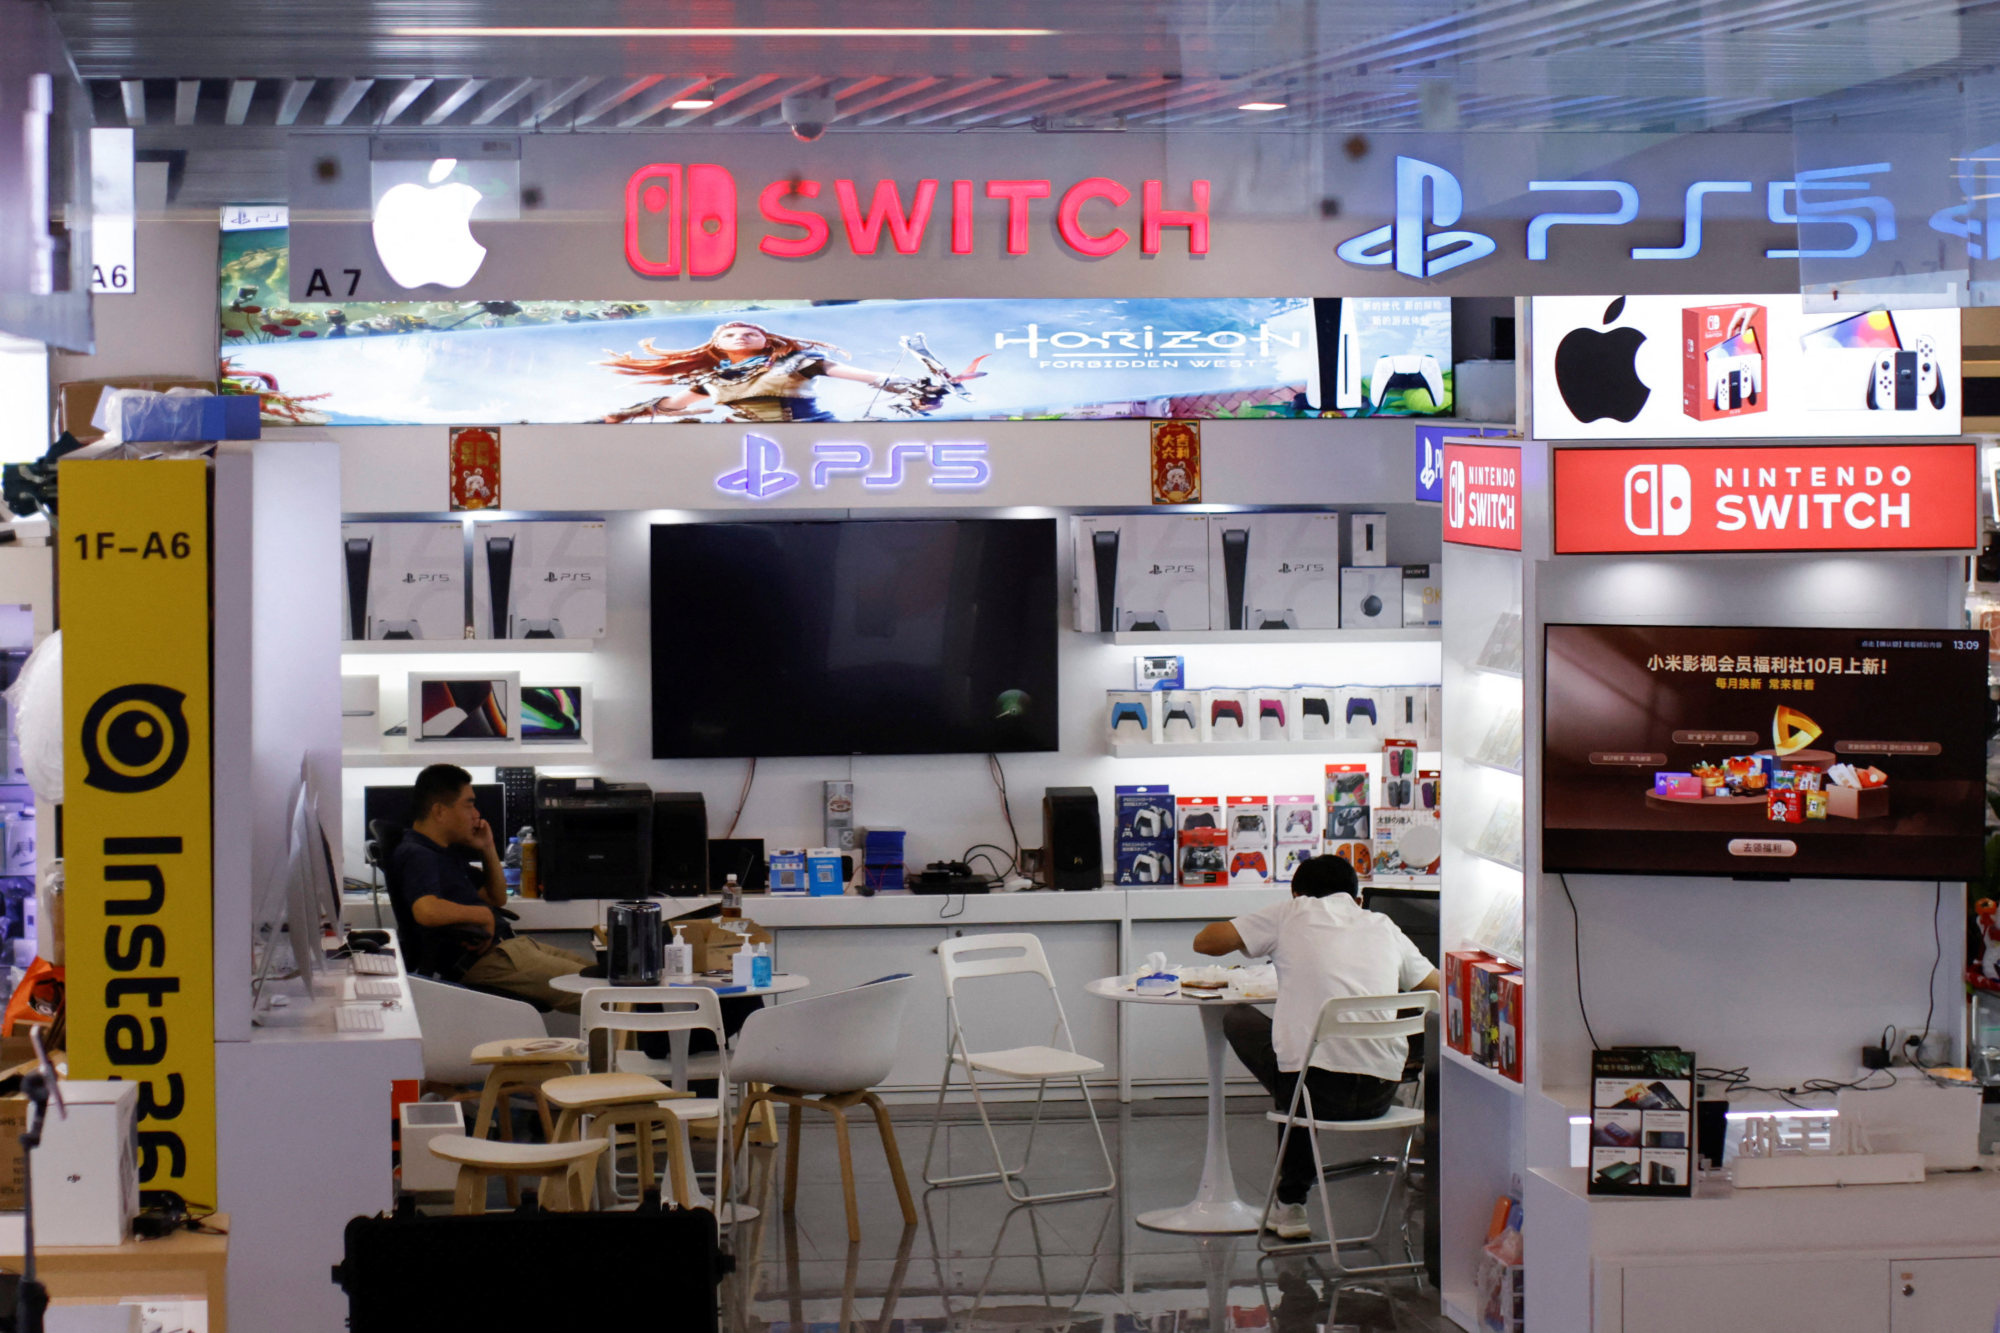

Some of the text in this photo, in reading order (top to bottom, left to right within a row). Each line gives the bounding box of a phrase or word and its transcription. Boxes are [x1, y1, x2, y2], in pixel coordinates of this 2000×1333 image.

[758, 178, 1211, 258] SWITCH
[1525, 180, 1873, 259] PS5
[995, 323, 1300, 358] HORIZON
[1039, 360, 1257, 369] FORBIDDEN WEST
[811, 442, 990, 487] PS5
[1468, 466, 1516, 488] NINTENDO
[1715, 465, 1912, 488] NINTENDO
[1468, 491, 1515, 530] SWITCH
[1715, 493, 1912, 531] SWITCH
[74, 532, 191, 560] 1F-A6
[418, 573, 450, 582] PS5
[560, 572, 592, 582] PS5
[1165, 565, 1195, 573] PS5
[1294, 563, 1324, 572] PS5
[1953, 640, 1980, 650] 13:09
[103, 836, 187, 1212] Insta36
